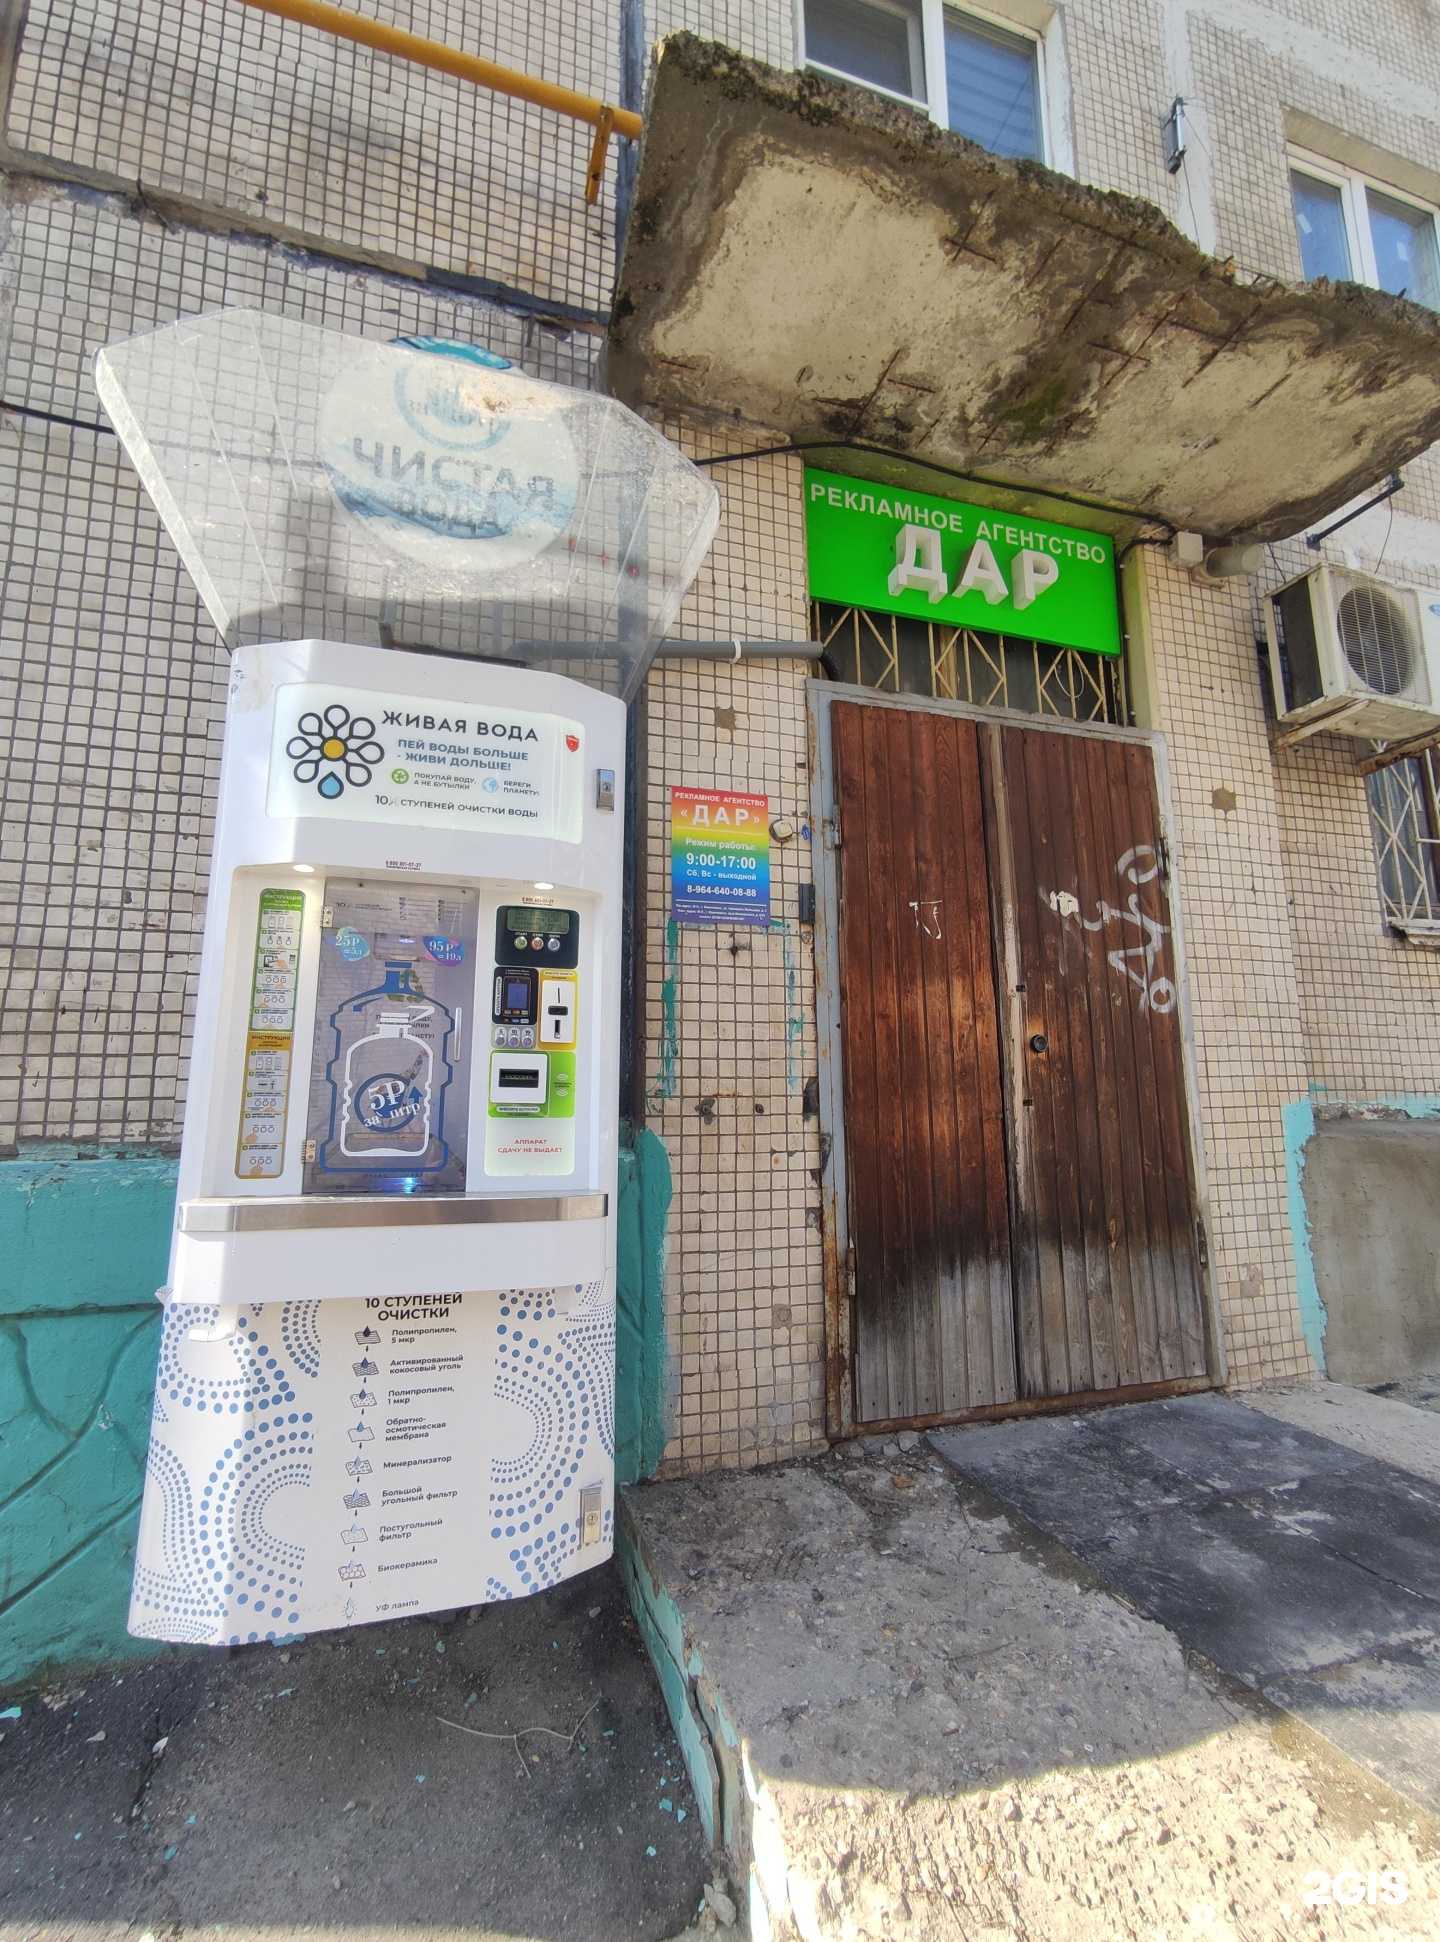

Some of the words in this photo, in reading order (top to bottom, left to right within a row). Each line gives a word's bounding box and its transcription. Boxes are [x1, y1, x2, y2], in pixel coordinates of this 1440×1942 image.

[811, 483, 963, 533] РЕКЛАМНОЕ
[976, 520, 1106, 564] АГЕНТСТВО
[888, 523, 1059, 611] ДАР
[382, 710, 467, 734] ЖИВАЯ
[477, 721, 538, 741] ВОДА
[398, 738, 424, 750] ПЕЙ
[429, 742, 468, 755] ВОДЫ
[473, 747, 528, 761] БОЛЬШЕ
[405, 752, 446, 765] ЖИВИ
[450, 758, 511, 771] ДОЛЬШЕ!
[414, 772, 452, 781] ПОКУПАЙ
[433, 782, 470, 790] БУТЫЛКИ
[503, 780, 531, 788] БЕРЕГИ
[675, 791, 720, 802] РЕКЛАМНОЕ
[723, 796, 766, 807] АГЕНТСТВО
[400, 799, 455, 811] СТУПЕНЕЙ
[458, 804, 506, 815] ОЧИСТКИ
[508, 809, 538, 818] ВОДЫ
[686, 852, 757, 870] 9:00-17:00
[718, 872, 757, 881] выходной
[365, 1297, 380, 1308] 10
[384, 1291, 463, 1308] СТУПЕНЕЙ
[378, 1307, 449, 1321] ОЧИСТКИ
[391, 1326, 457, 1336] Полипропилен,
[390, 1354, 464, 1367] Активированный
[389, 1364, 436, 1375] кокосовый
[438, 1363, 461, 1372] уголь
[388, 1386, 455, 1397] Полипропилен,
[385, 1422, 446, 1434] осмотическая
[386, 1417, 426, 1427] Обратно-
[385, 1432, 430, 1442] мембрана
[383, 1455, 452, 1469] Минерализатор
[382, 1486, 422, 1497] Большой
[381, 1495, 424, 1507] угольный
[426, 1490, 458, 1501] фильтр
[380, 1518, 443, 1533] Постугольный
[379, 1531, 412, 1543] фильтр
[377, 1558, 438, 1572] Биокерамика
[392, 1599, 419, 1609] лампа
